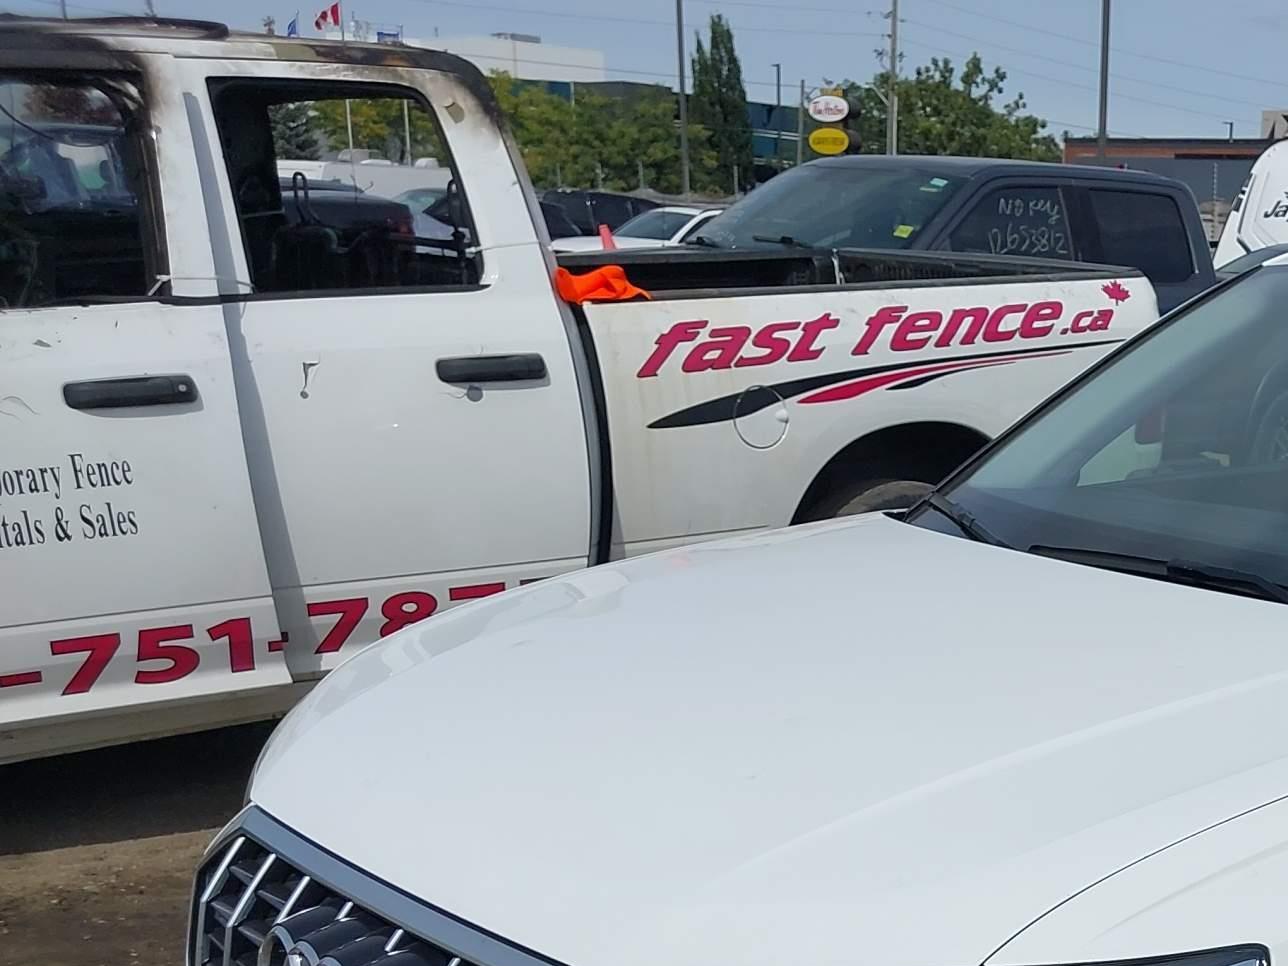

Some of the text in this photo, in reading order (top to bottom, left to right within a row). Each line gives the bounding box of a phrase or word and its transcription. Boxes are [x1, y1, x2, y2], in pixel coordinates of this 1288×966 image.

[636, 312, 841, 379] fast
[0, 453, 134, 500] orary Fence
[0, 502, 139, 549] tals & Sales
